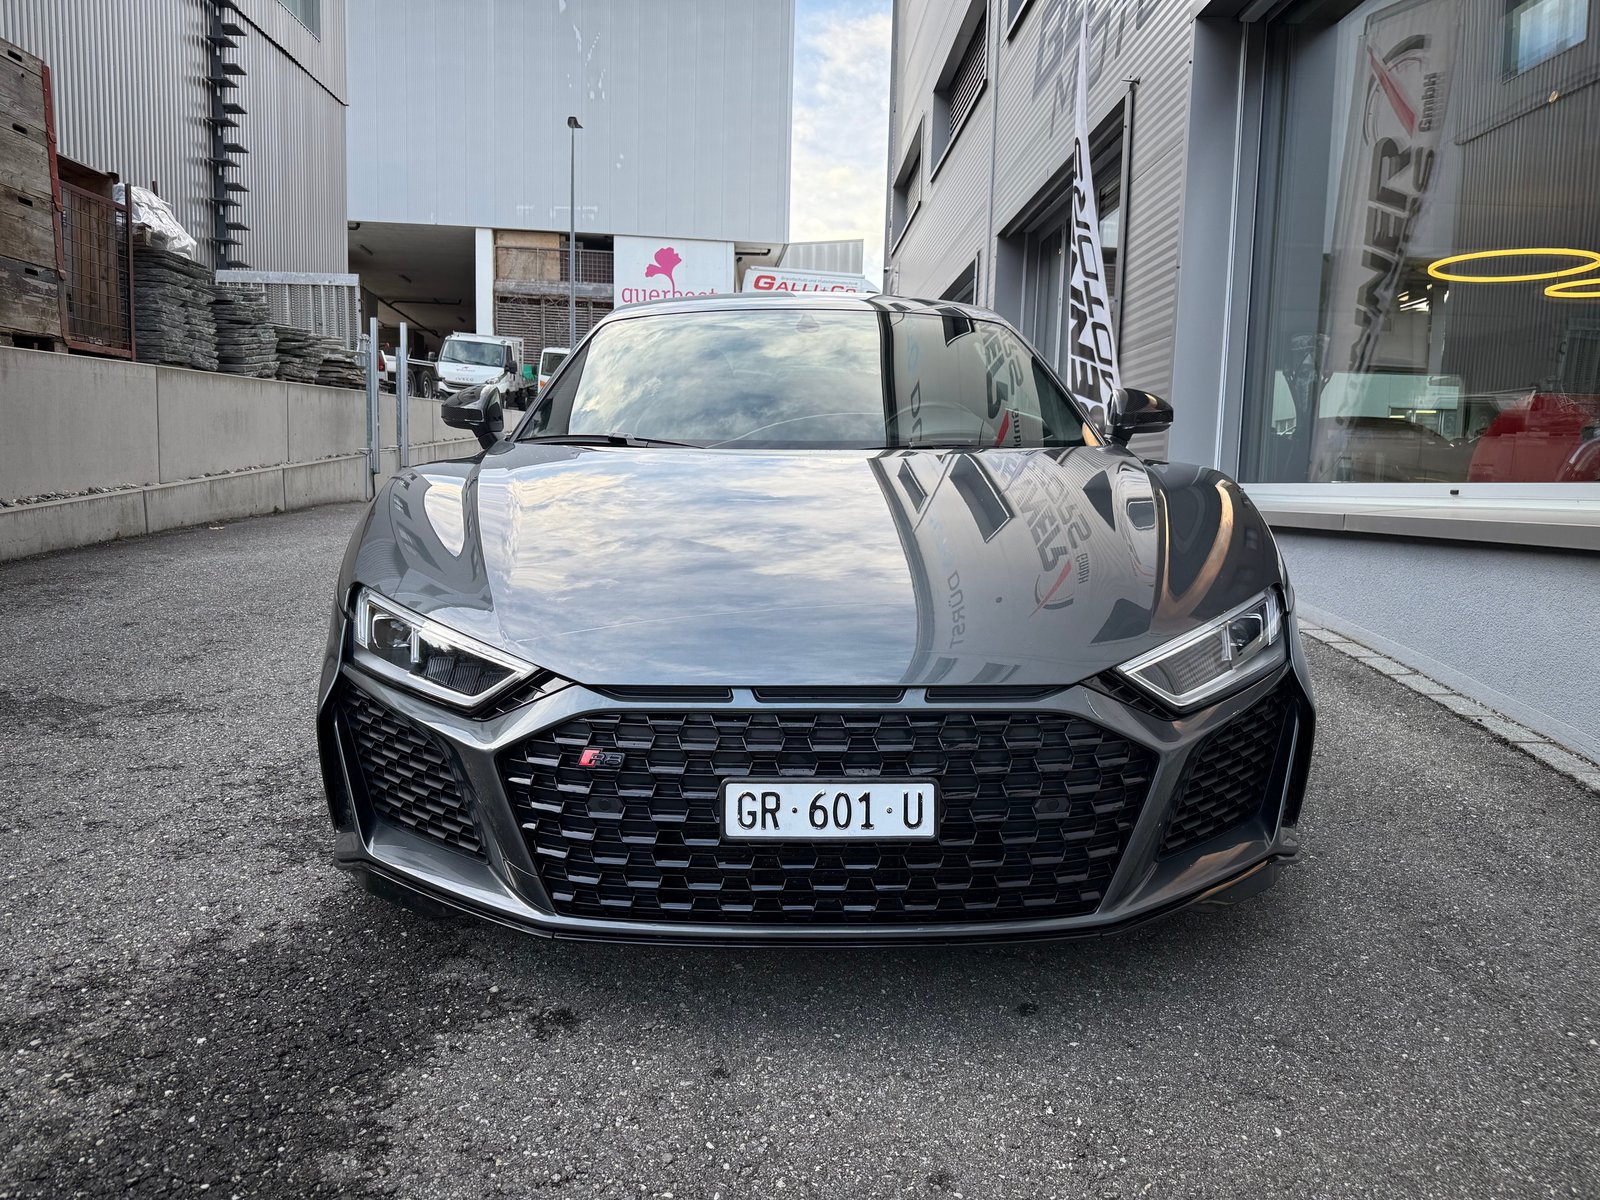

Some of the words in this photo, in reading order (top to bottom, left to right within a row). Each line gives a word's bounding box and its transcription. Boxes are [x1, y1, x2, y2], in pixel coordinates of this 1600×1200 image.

[737, 790, 781, 830] GR
[808, 789, 875, 830] 601
[902, 790, 924, 830] U
